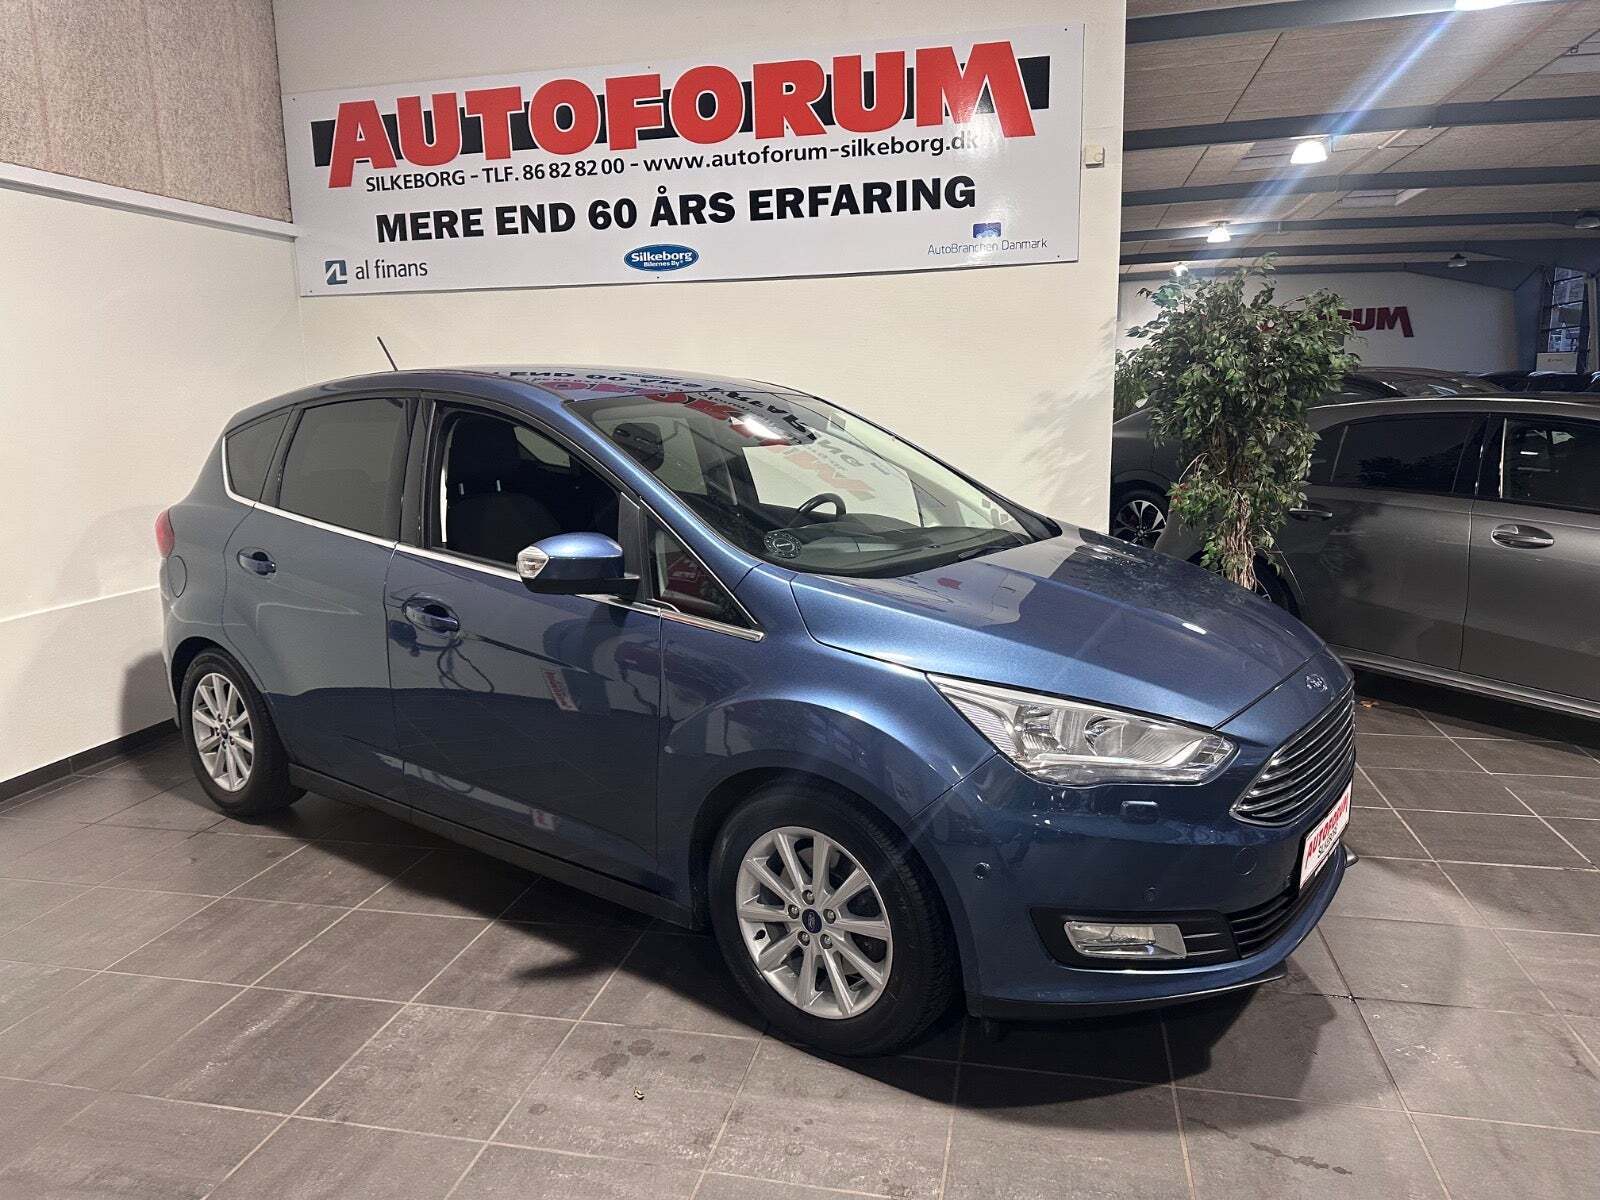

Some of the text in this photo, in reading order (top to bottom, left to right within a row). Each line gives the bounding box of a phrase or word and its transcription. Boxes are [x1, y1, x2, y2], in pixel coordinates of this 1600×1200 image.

[328, 41, 1036, 189] AUTOFORUM
[365, 169, 466, 192] SILKEBORG
[482, 166, 519, 184] TLF.
[522, 162, 546, 181] 86
[548, 161, 572, 179] 82
[574, 160, 599, 177] 82
[601, 157, 626, 176] 00
[643, 130, 978, 172] www.autoforum-silkeborg.dk
[376, 175, 977, 243] MERE END 60 ÅRS ERFARING
[631, 250, 693, 262] Silkeborg
[1001, 238, 1048, 251] Danmark
[355, 259, 428, 280] al finans
